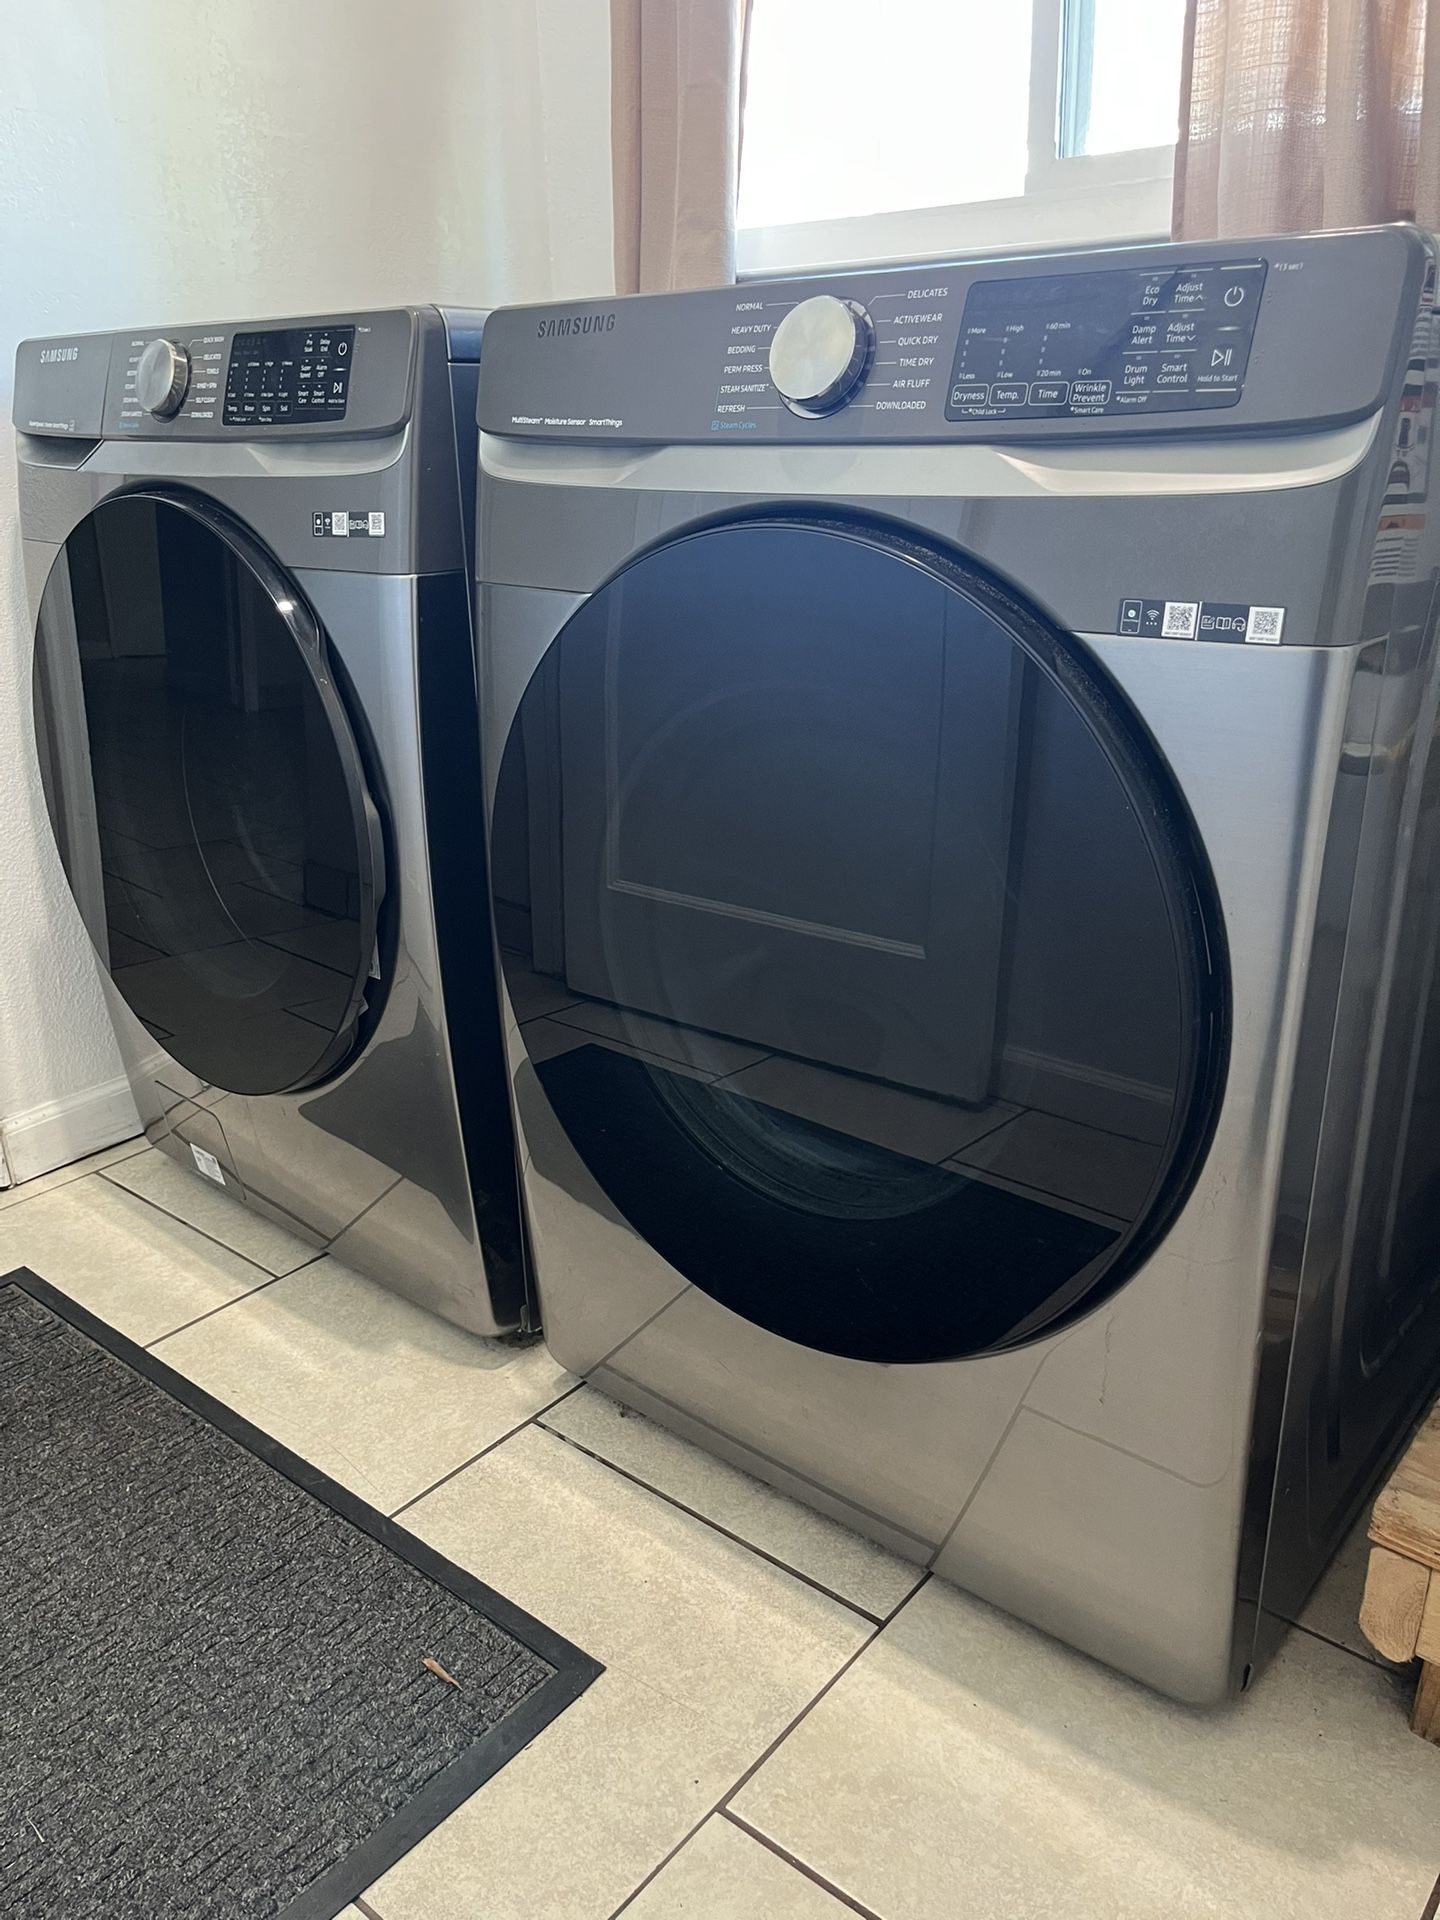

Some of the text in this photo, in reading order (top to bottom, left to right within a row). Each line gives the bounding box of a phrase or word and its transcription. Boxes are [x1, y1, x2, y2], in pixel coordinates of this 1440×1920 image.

[907, 287, 948, 299] DELICATES
[1145, 285, 1160, 295] Eco
[1175, 282, 1203, 294] Adjust
[1142, 296, 1158, 307] Dry
[1174, 294, 1194, 303] Time
[735, 301, 763, 312] NORMAL
[893, 312, 943, 325] ACTIVEWEAR
[537, 313, 616, 338] SAMSUNG
[731, 324, 771, 335] HEAVY DUTY
[1008, 324, 1024, 333] High
[1132, 325, 1157, 335] Damp
[1167, 323, 1195, 334] Adjust
[897, 335, 939, 347] QUICK DRY
[1131, 335, 1153, 345] Alert
[1166, 334, 1186, 343] Time
[727, 345, 756, 354] BEDDING
[40, 347, 79, 364] SAMSUNG
[899, 357, 935, 367] TIME DRY
[723, 364, 763, 374] PERM PRESS
[1124, 364, 1148, 374] Drum
[1161, 363, 1187, 373] Smart
[1123, 375, 1145, 386] Light
[1156, 374, 1188, 384] Control
[1221, 374, 1238, 382] Start
[892, 379, 931, 389] AIR FLUFF
[1074, 383, 1107, 393] Wrinkle
[719, 385, 741, 394] STEAM
[1038, 388, 1059, 399] Time
[953, 390, 985, 401] Dryness
[996, 389, 1019, 401] Temp.
[1072, 393, 1105, 403] Prevent
[1137, 395, 1148, 403] Off
[717, 404, 746, 413] REFRESH
[875, 400, 927, 410] DOWNLOADED
[1091, 406, 1104, 414] Care
[544, 417, 567, 426] Moisture
[567, 418, 586, 426] Sensor
[588, 418, 623, 428] SmartThings
[720, 421, 739, 430] Steam
